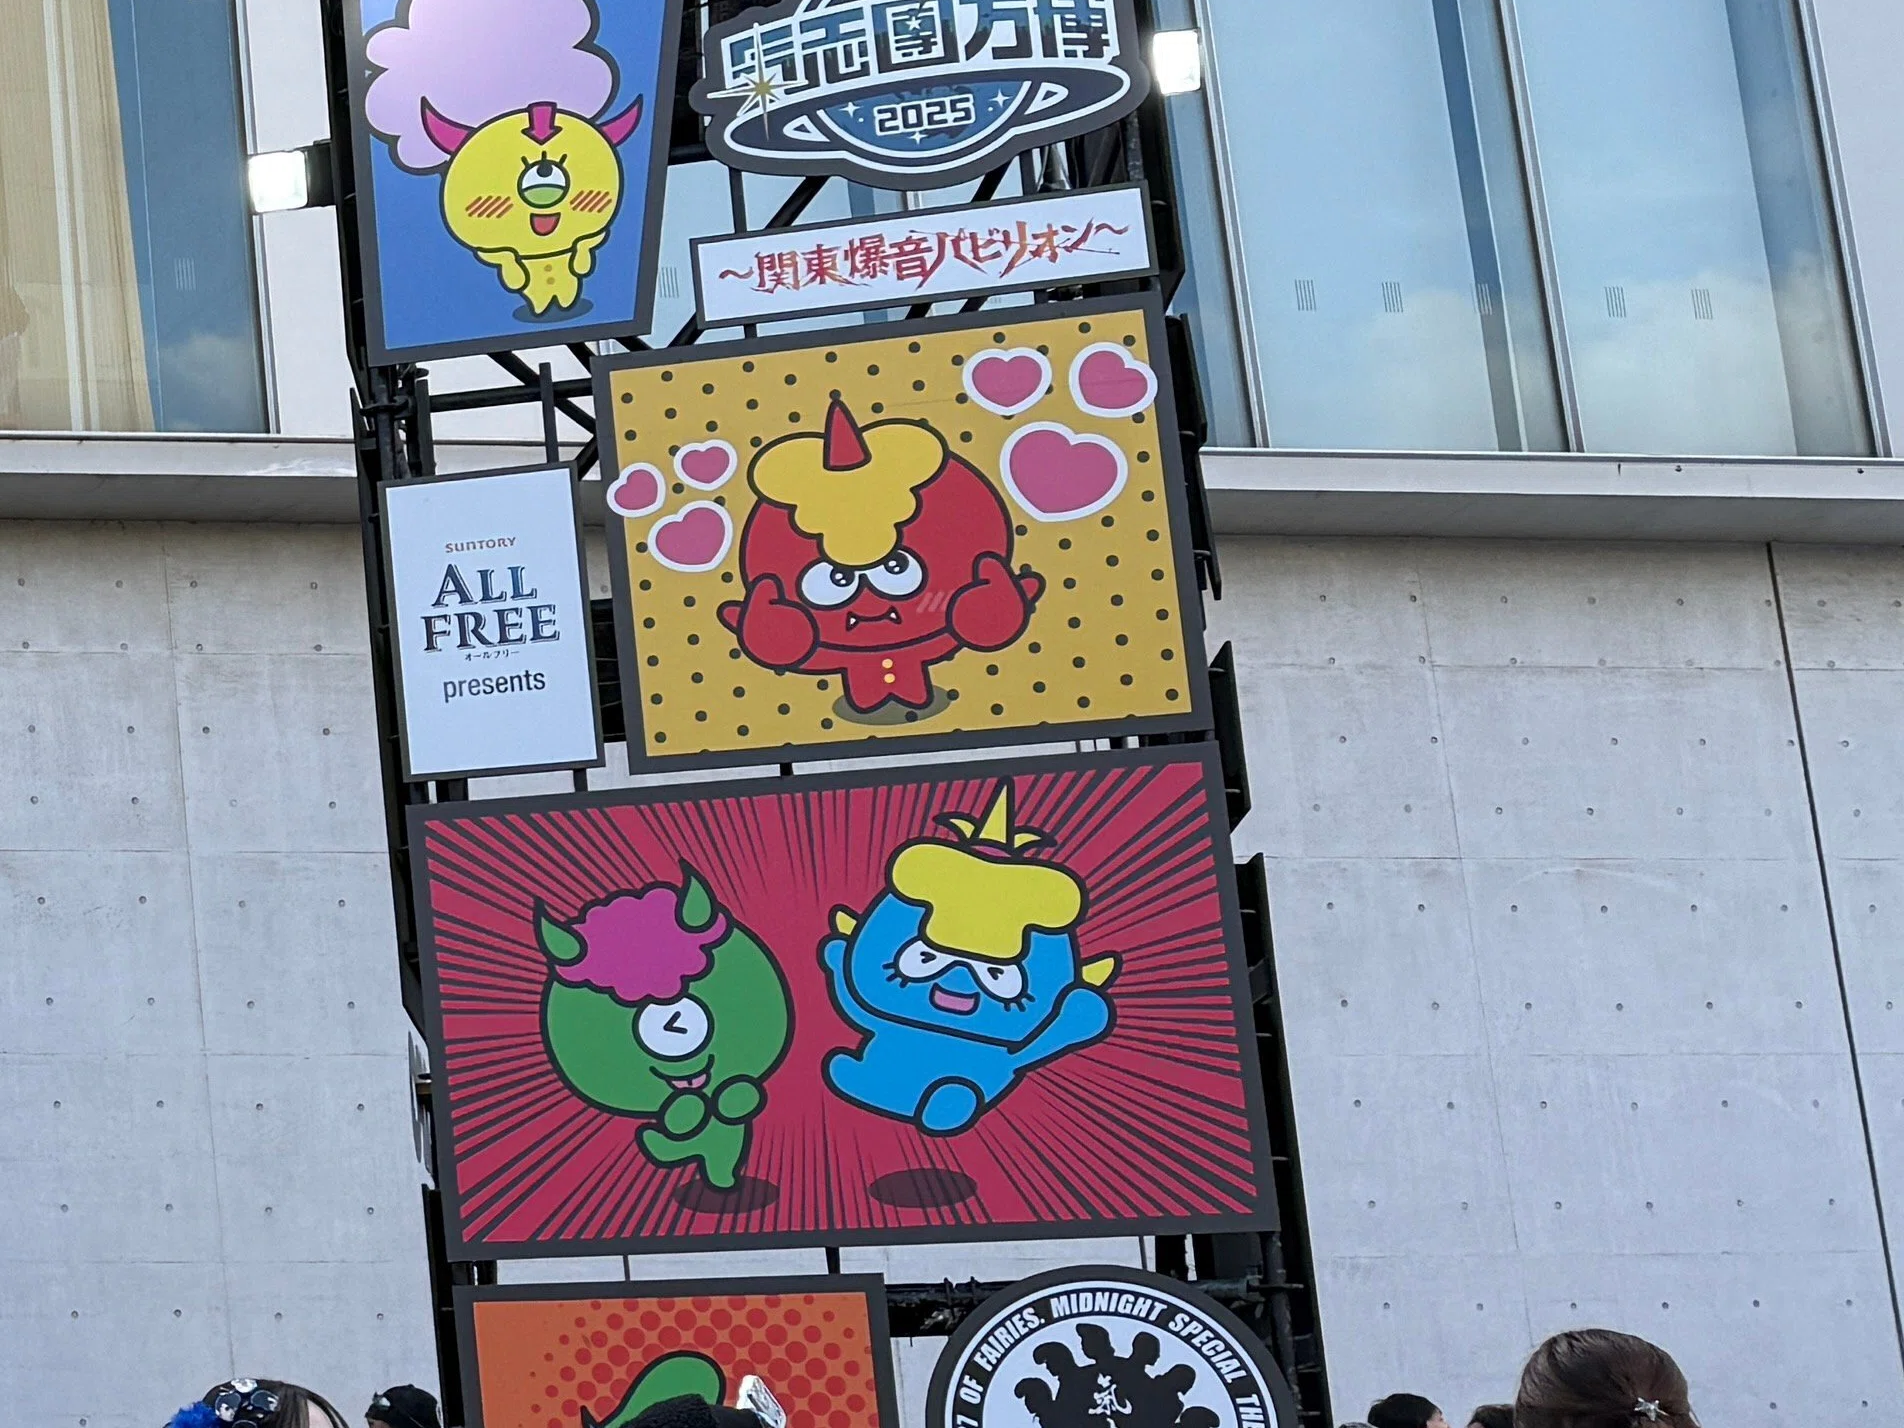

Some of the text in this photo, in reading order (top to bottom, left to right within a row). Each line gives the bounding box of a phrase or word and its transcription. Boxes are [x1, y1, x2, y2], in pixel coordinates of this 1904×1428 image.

[875, 94, 975, 136] 2025
[445, 537, 516, 553] SUNTORY
[431, 563, 538, 608] ALL
[420, 604, 560, 653] FREE
[465, 649, 520, 661] オールフリー
[443, 669, 546, 703] presents
[959, 1373, 985, 1405] OF
[1050, 1291, 1168, 1322] MIDNIGHT
[1168, 1312, 1247, 1384] SPECIAL
